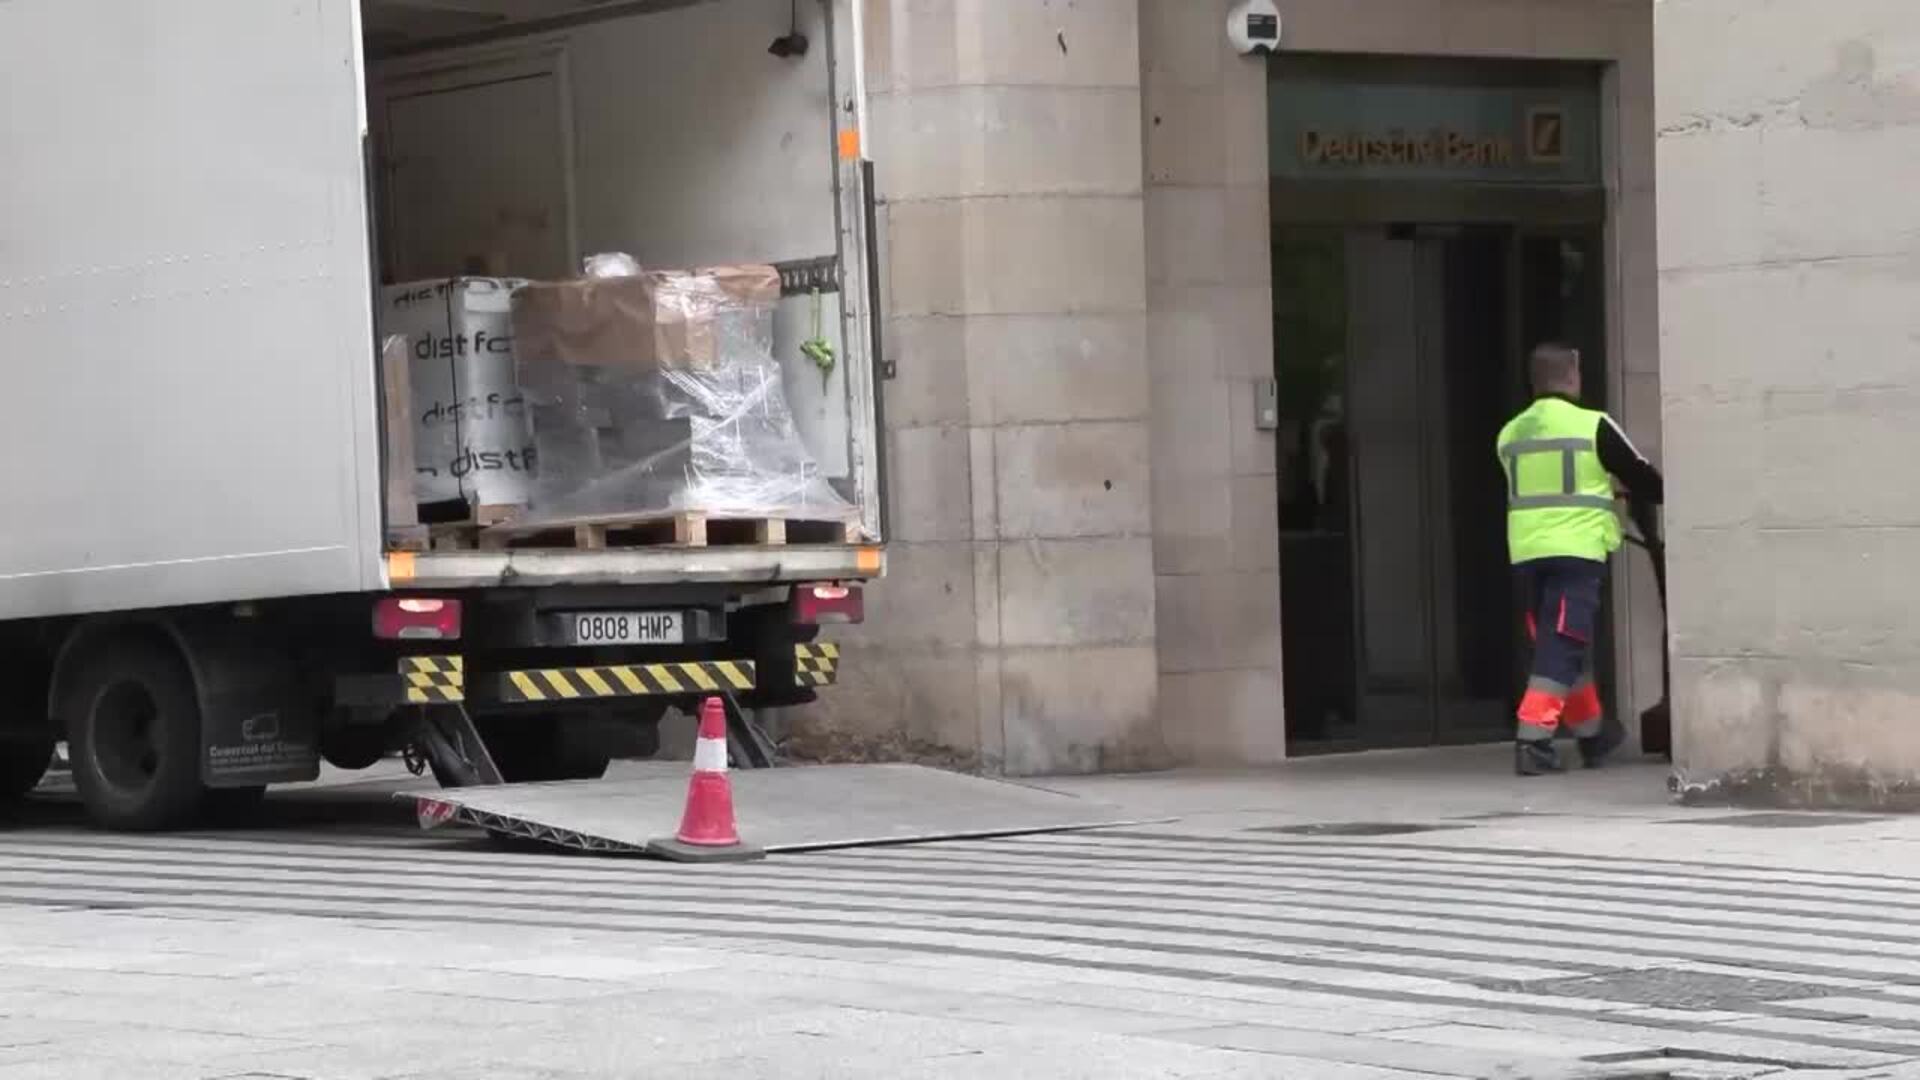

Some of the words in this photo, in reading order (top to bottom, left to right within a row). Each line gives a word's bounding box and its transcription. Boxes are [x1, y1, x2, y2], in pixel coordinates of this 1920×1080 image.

[1300, 130, 1433, 162] Deutsche
[1443, 131, 1511, 163] Bank
[580, 616, 628, 640] 0808
[638, 615, 673, 640] HMP
